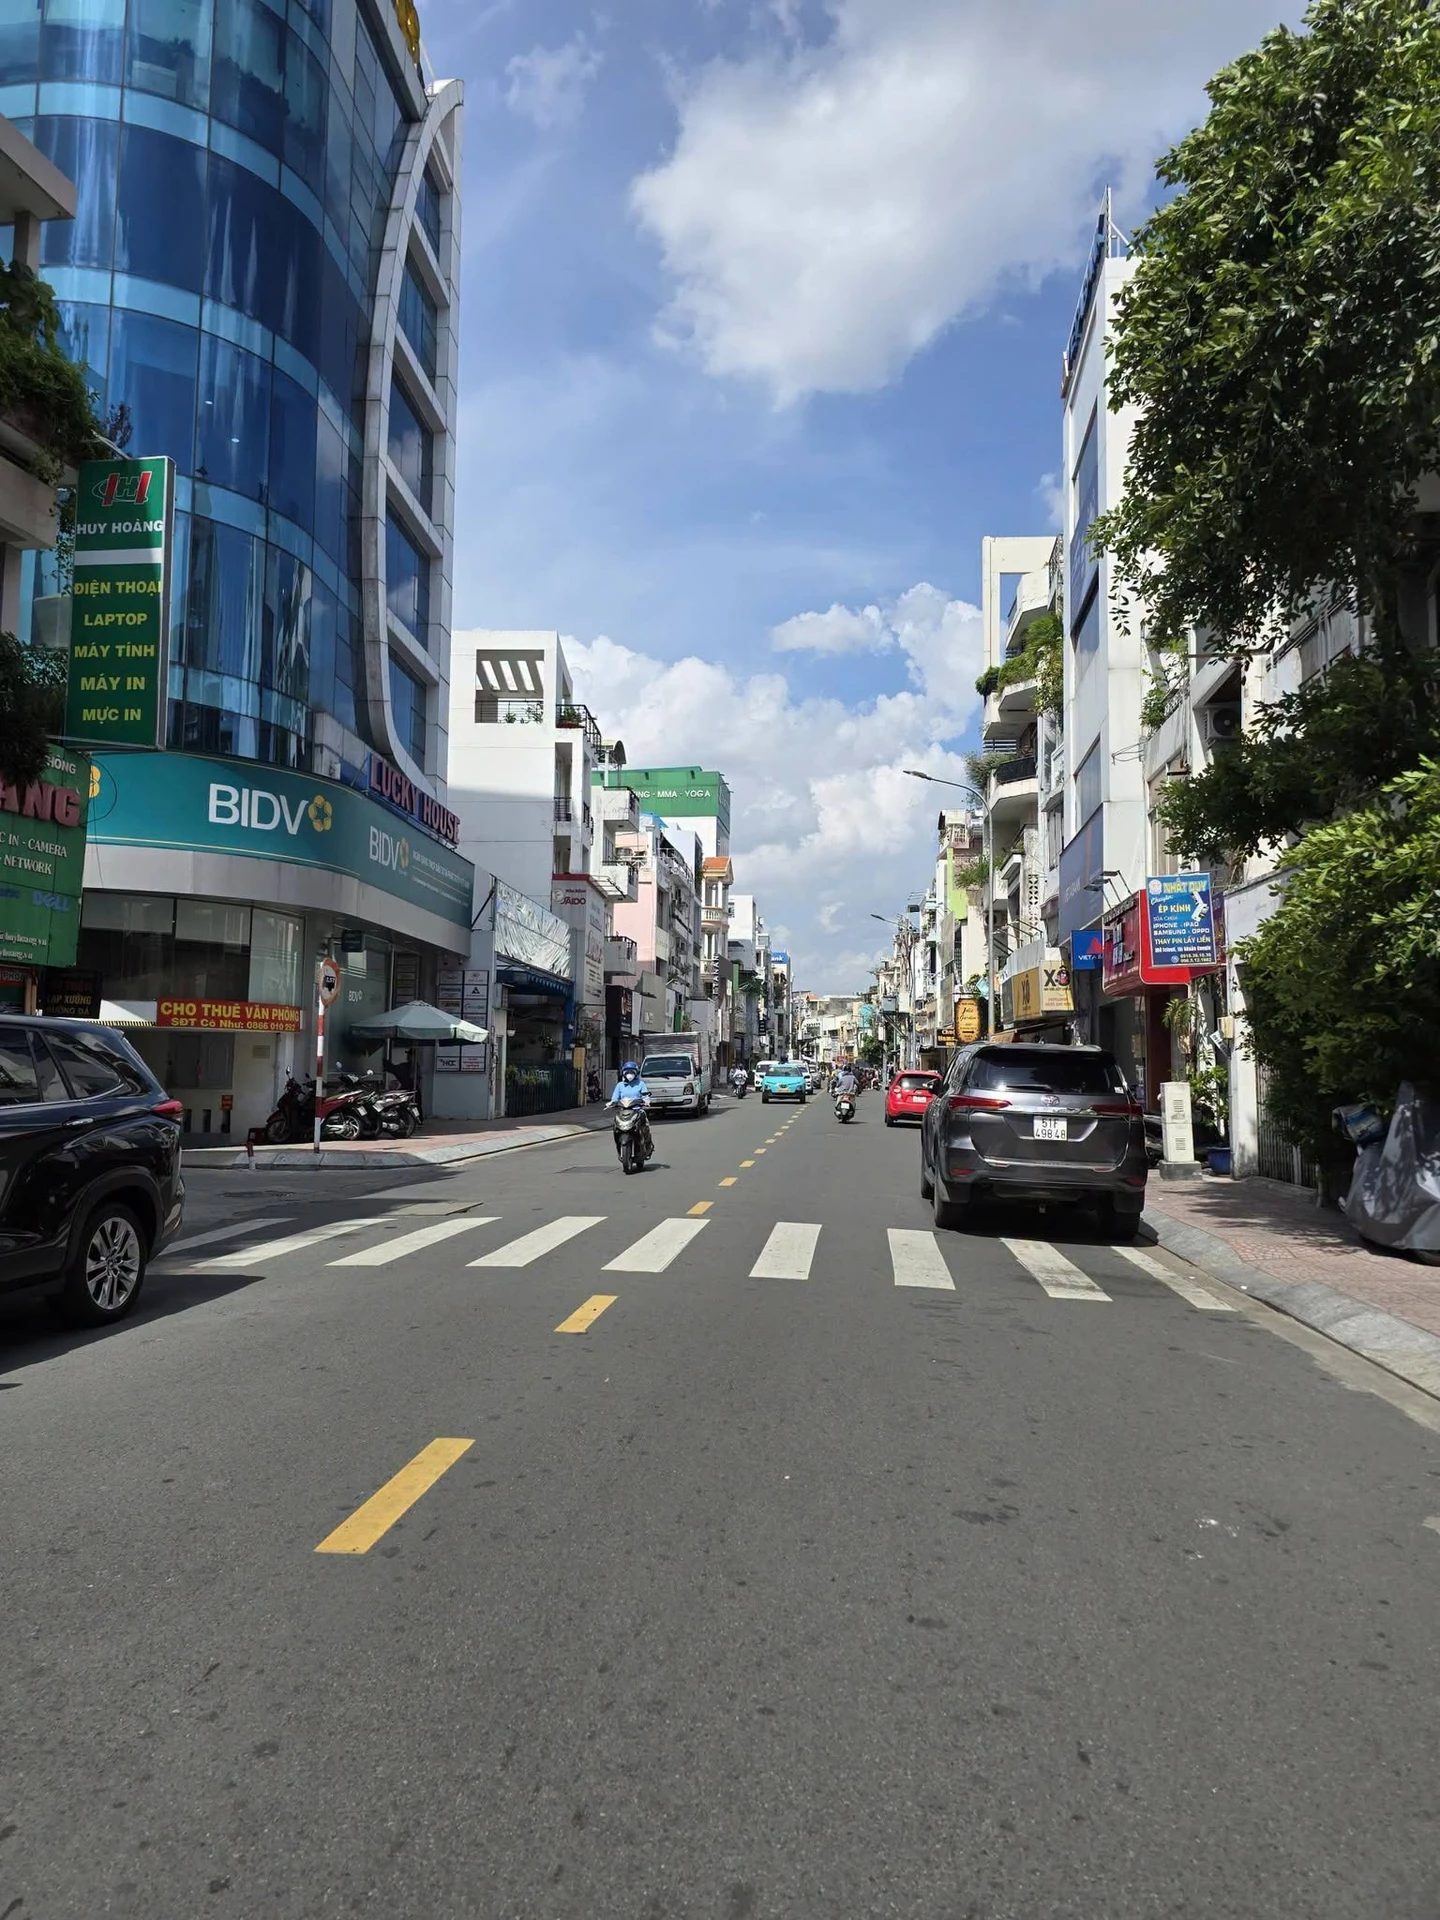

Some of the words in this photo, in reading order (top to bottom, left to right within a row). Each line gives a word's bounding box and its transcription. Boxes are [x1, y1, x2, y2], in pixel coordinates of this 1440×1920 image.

[76, 523, 107, 535] HUY
[111, 518, 164, 533] HOÀNG
[74, 580, 111, 598] ĐIỆN
[116, 581, 163, 596] THOẠI
[83, 613, 148, 626] LAPTOP
[74, 642, 110, 657] MÁY
[115, 641, 155, 657] TÍNH
[81, 673, 120, 690] MÁY
[126, 677, 145, 690] IN
[82, 706, 119, 724] MỰC
[124, 709, 141, 720] IN
[370, 750, 421, 817] LUCKY
[423, 794, 461, 845] HOUSE
[633, 790, 650, 798] ING
[657, 790, 677, 798] MMA
[208, 783, 309, 835] BIDV
[8, 833, 19, 846] IN
[28, 838, 67, 858] CAMERA
[369, 826, 400, 871] BIDV
[3, 854, 52, 875] NETWORK
[33, 889, 70, 911] DELL
[1170, 903, 1191, 913] KÍNH
[1153, 922, 1178, 930] IPHONE
[160, 1002, 197, 1016] CHO
[201, 1003, 240, 1019] THUÊ
[245, 1004, 270, 1020] VĂN
[271, 1006, 299, 1022] PHÒNG
[171, 1017, 197, 1027] SĐT
[246, 1021, 269, 1030] 0866
[1041, 1117, 1059, 1128] 51F
